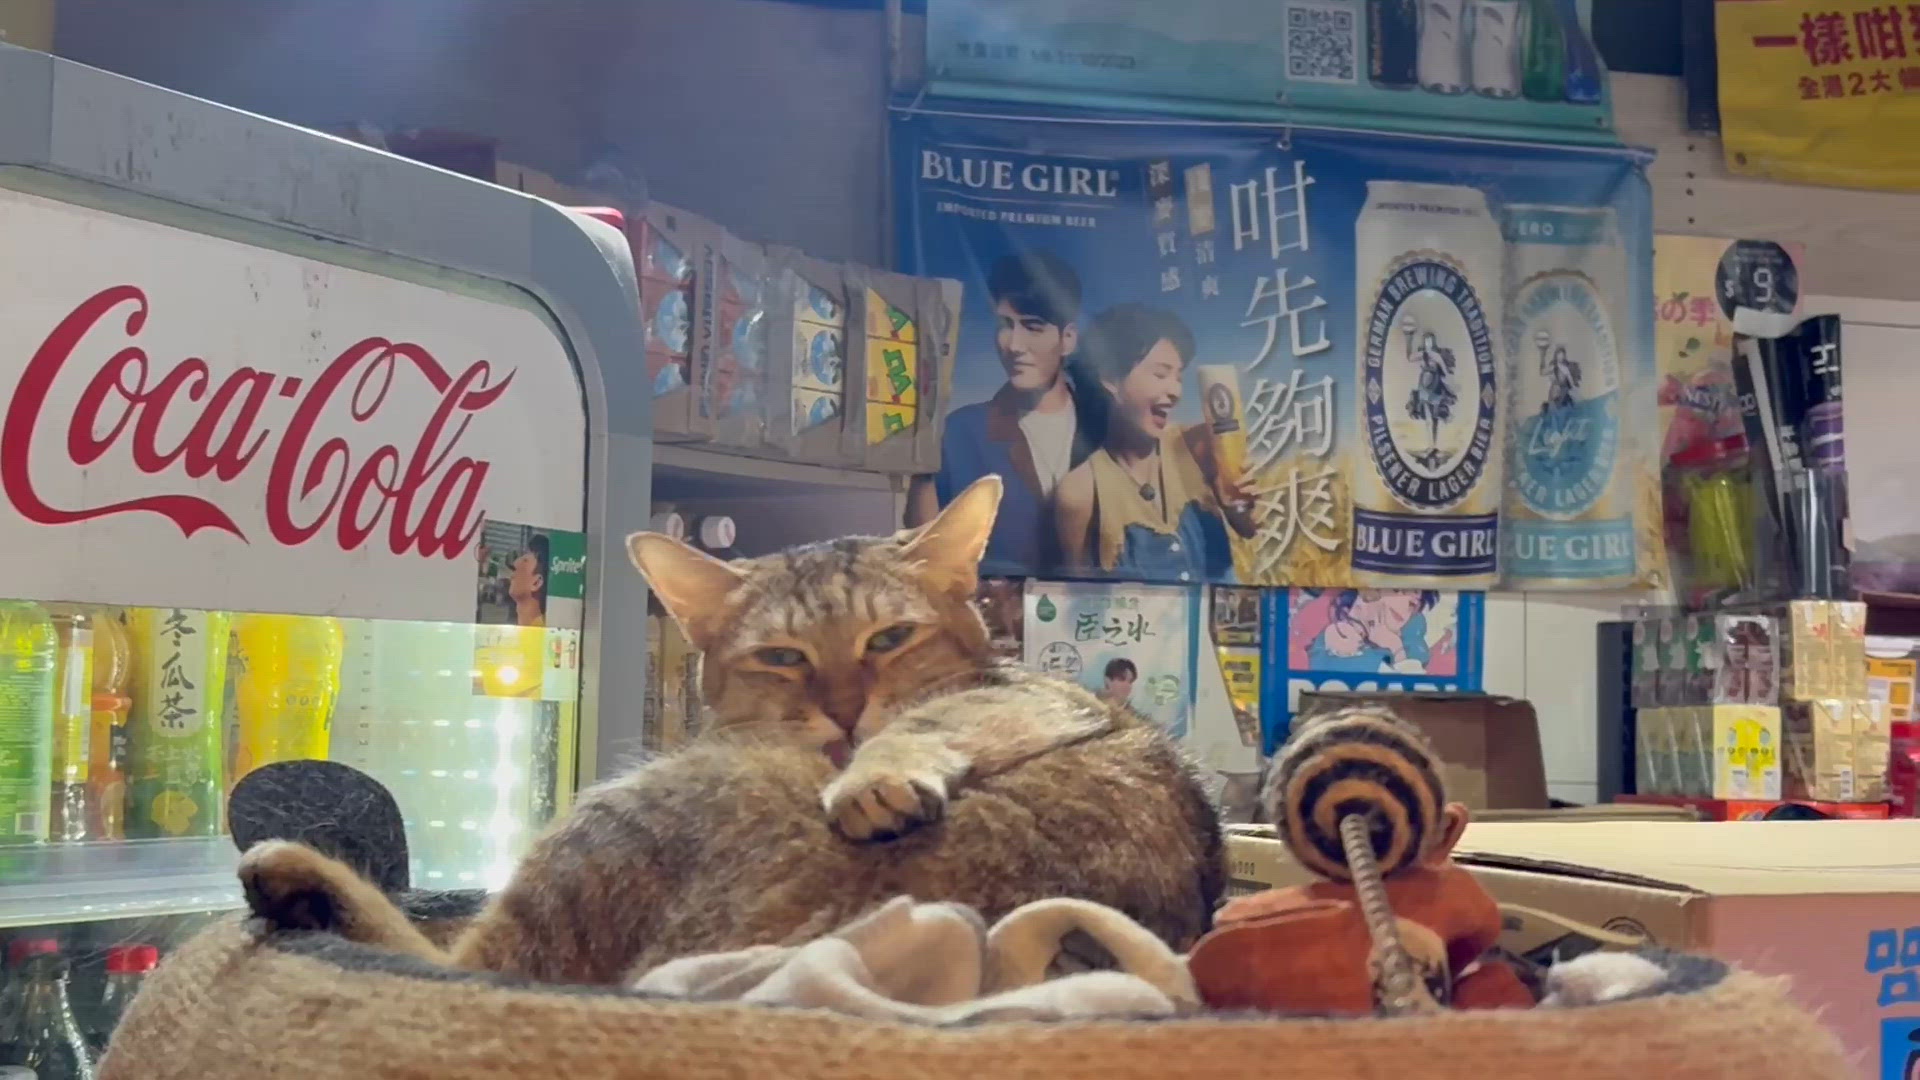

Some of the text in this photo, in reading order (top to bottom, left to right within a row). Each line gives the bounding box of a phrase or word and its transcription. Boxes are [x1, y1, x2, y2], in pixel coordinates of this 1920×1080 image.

[1752, 5, 1920, 67] 一樣咁
[921, 150, 1117, 198] BLUE GIRL
[1753, 266, 1773, 303] 9
[1367, 299, 1394, 368] GERMAN
[1387, 265, 1458, 301] BREWING
[1457, 288, 1494, 375] TRADITION
[1230, 160, 1343, 575] 咁先夠爽
[0, 285, 518, 560] Coca-Cola
[1371, 414, 1421, 497] PILSENER
[1428, 461, 1477, 501] LAGER
[1470, 417, 1491, 461] BIER
[551, 556, 583, 576] Sprite
[1356, 523, 1496, 559] BLUE GIRL
[1515, 533, 1558, 561] UE
[157, 608, 197, 729] 冬瓜茶
